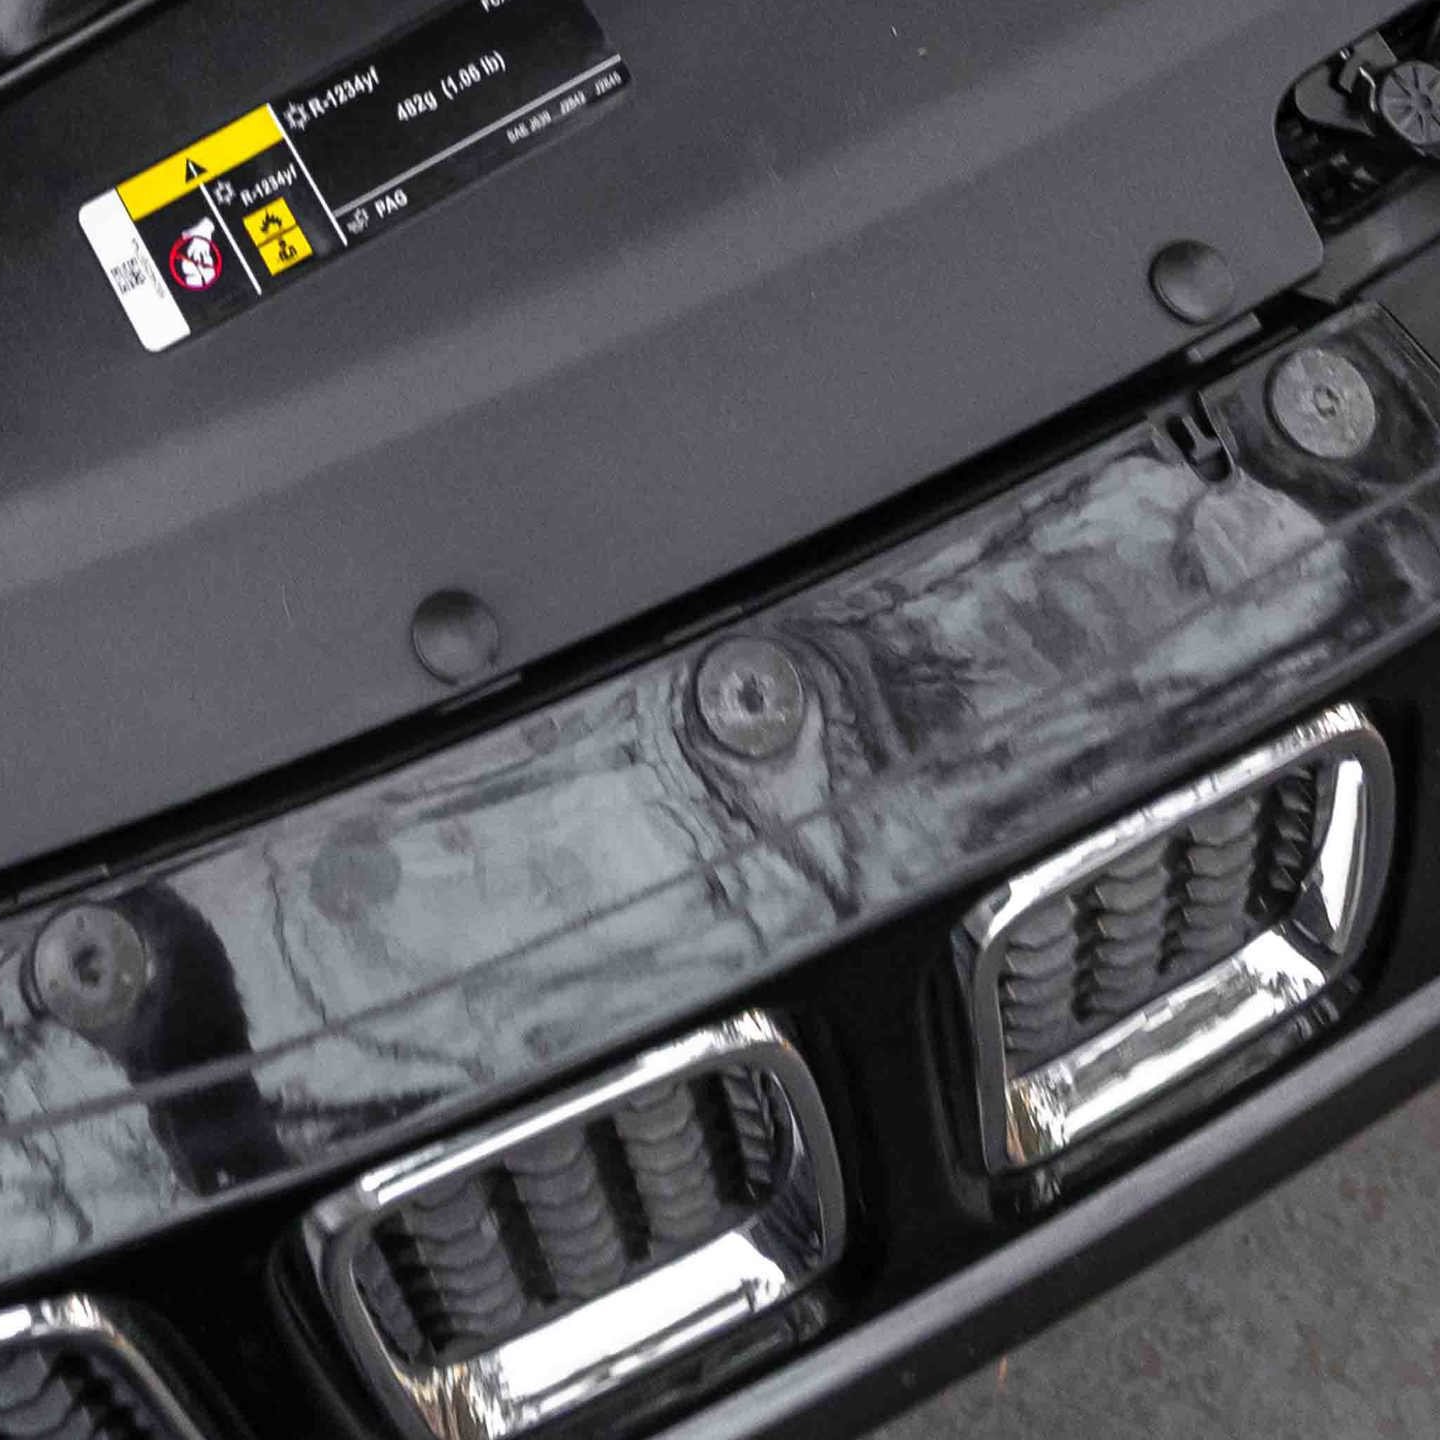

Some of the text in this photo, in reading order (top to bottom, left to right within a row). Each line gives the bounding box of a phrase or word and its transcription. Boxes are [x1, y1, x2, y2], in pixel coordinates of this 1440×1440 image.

[307, 64, 380, 119] R-1234yf
[240, 162, 298, 207] R-1234yf
[374, 188, 409, 219] PAG
